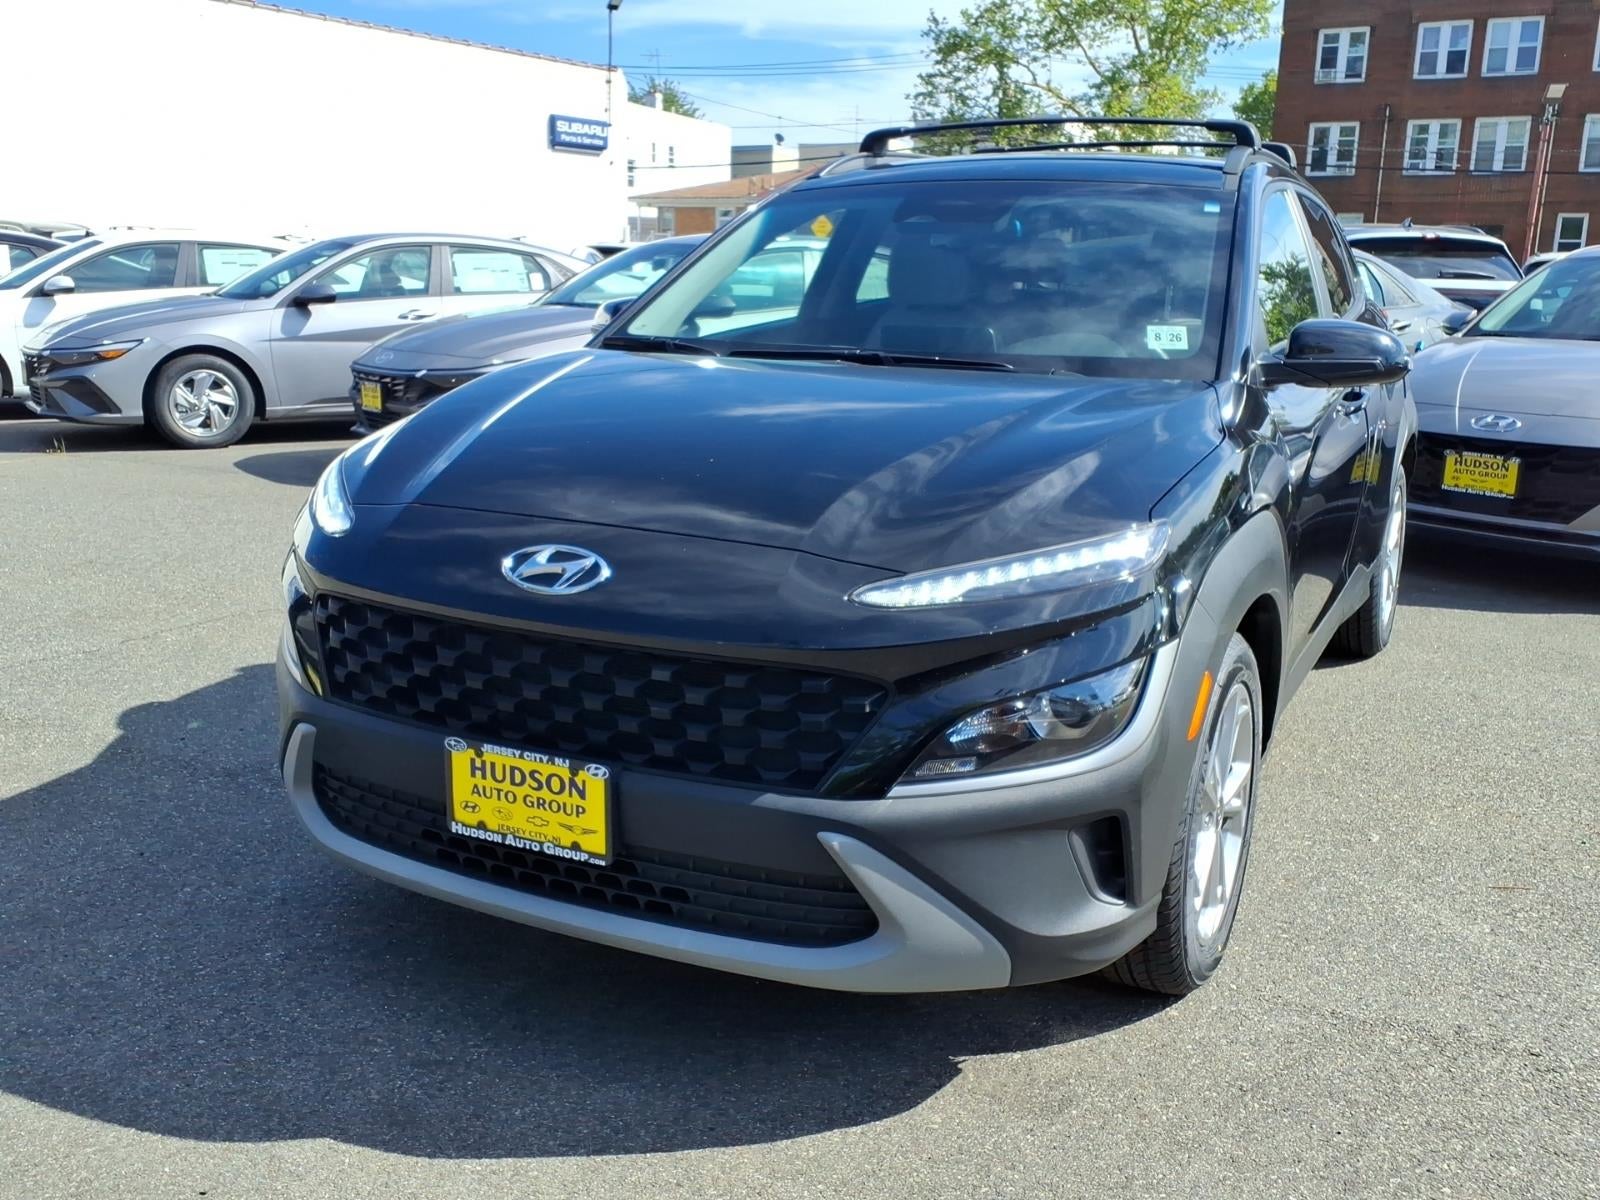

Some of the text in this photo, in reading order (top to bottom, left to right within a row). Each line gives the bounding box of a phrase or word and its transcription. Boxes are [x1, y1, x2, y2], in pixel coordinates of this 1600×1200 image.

[556, 120, 608, 137] SUBARU
[1154, 332, 1182, 342] 8 26
[1454, 457, 1509, 472] HUDSON
[1453, 468, 1508, 480] AUTO GROUP
[481, 743, 521, 759] JERSEY
[554, 757, 570, 768] NJ
[470, 757, 587, 801] HUDSON
[471, 783, 586, 818] AUTO GROUP
[497, 823, 527, 836] JERSEY
